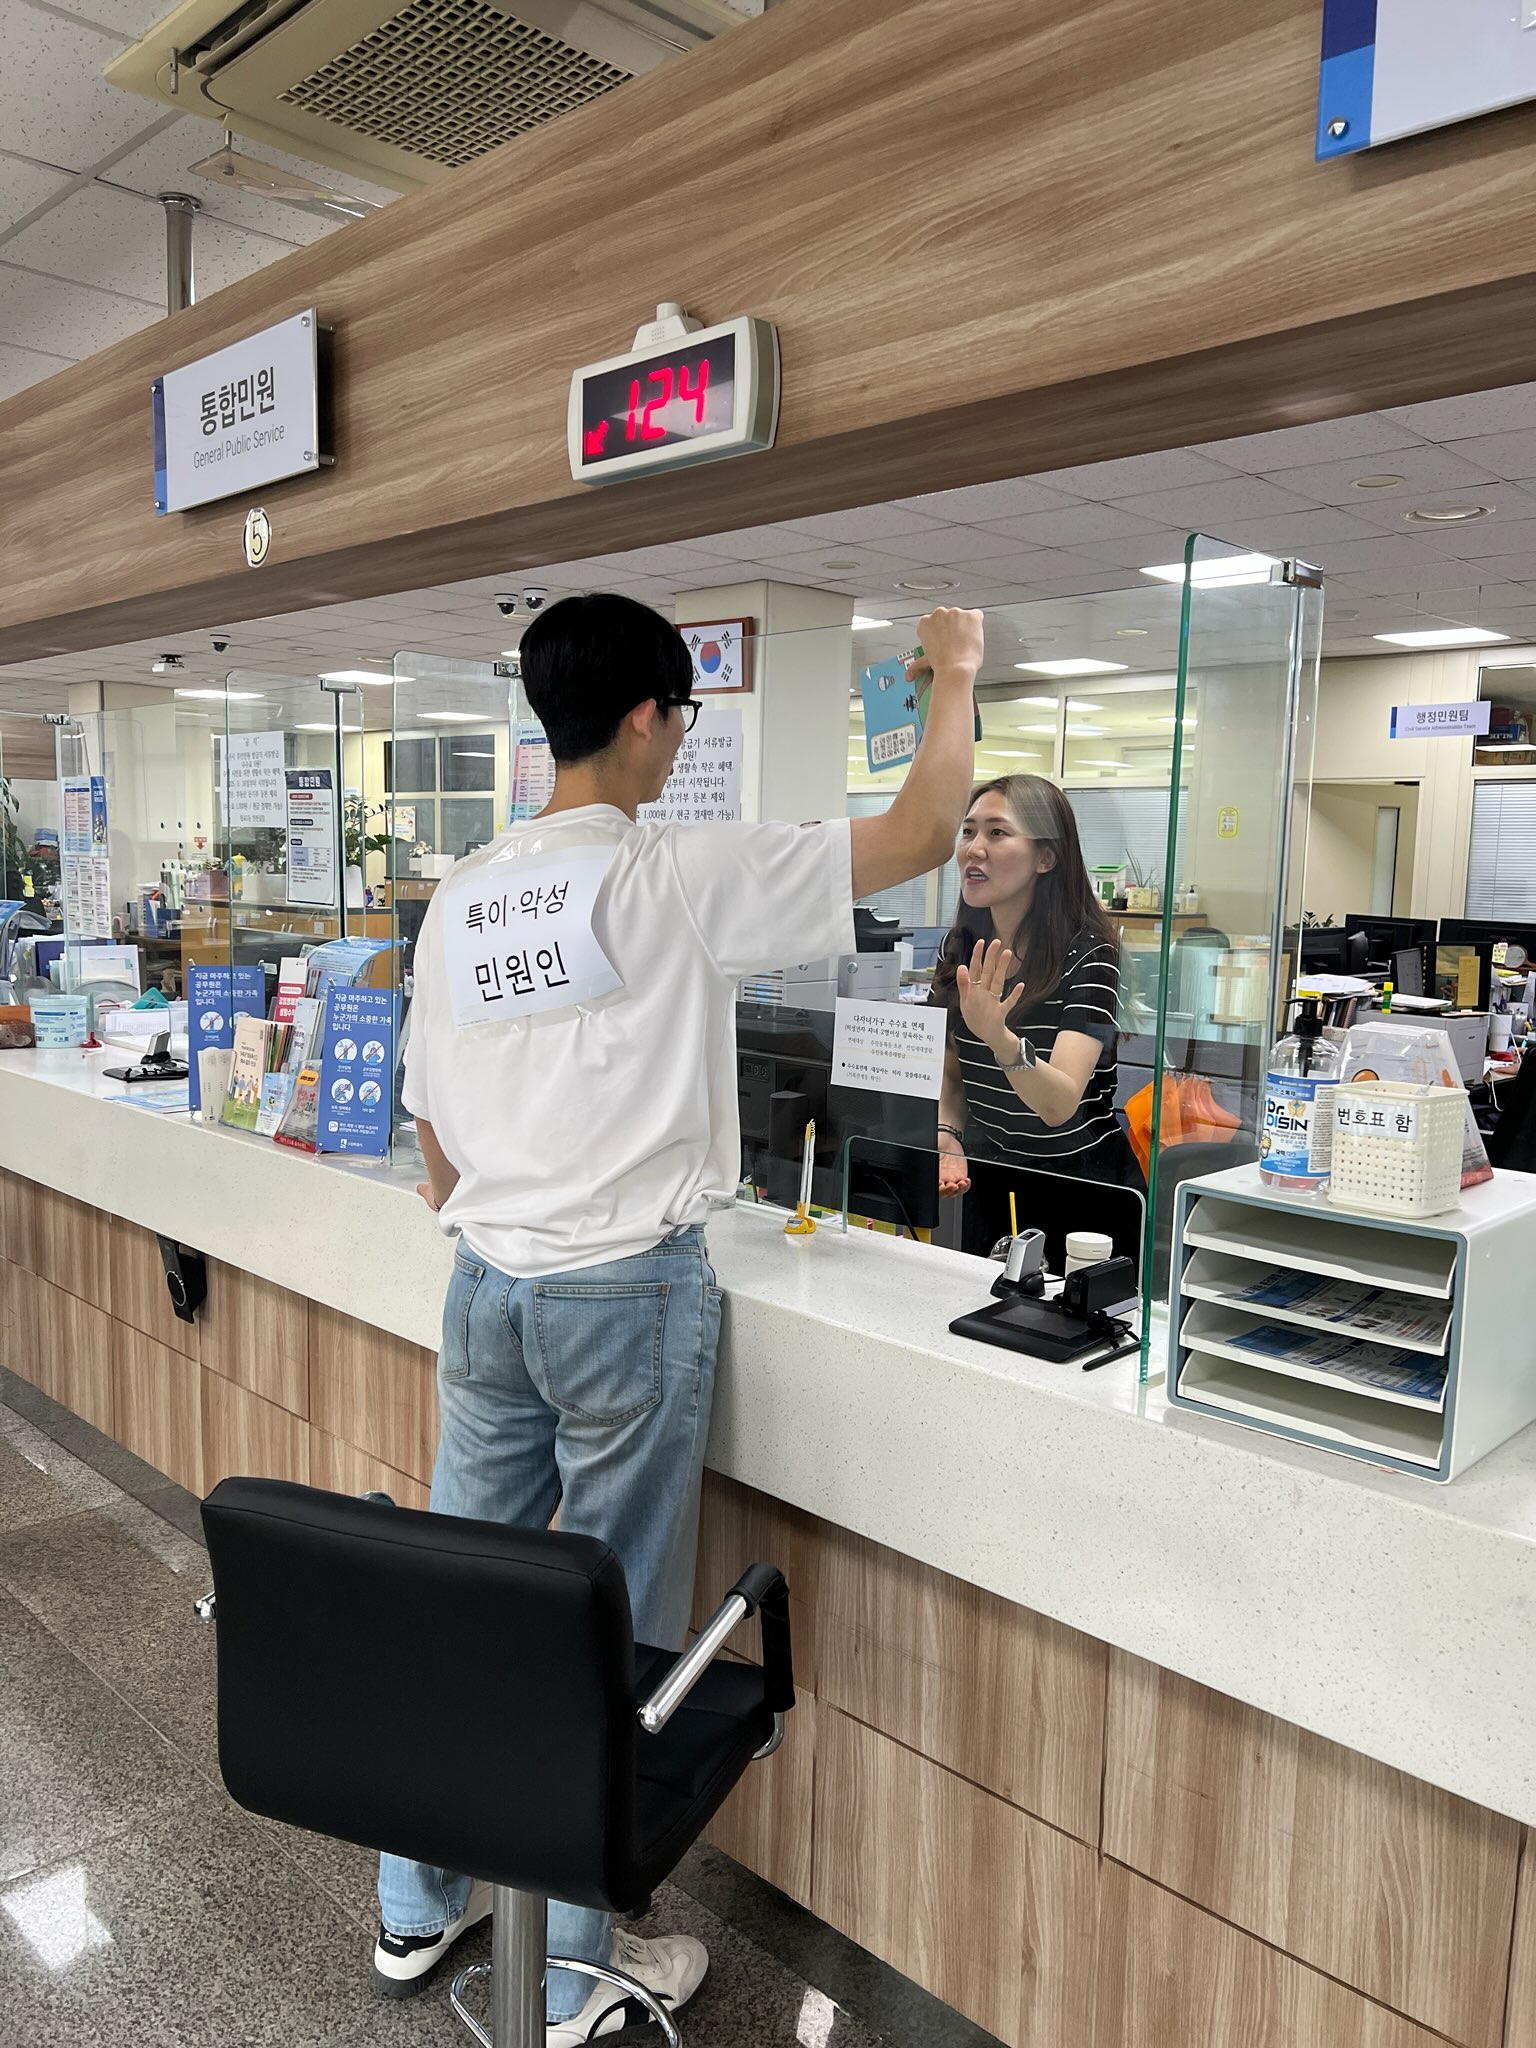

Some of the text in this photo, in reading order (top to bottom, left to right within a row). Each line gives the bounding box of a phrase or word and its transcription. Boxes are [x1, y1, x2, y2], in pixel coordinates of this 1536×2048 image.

[200, 366, 275, 436] 통합민원
[626, 359, 709, 441] 124
[194, 424, 285, 469] General Public Service
[252, 518, 263, 556] 5
[1416, 709, 1469, 724] 행정민원팀
[704, 736, 732, 748] 서류발급
[678, 762, 698, 774] 생활속
[700, 762, 714, 772] 작은
[298, 776, 320, 788] 통합민원
[688, 776, 727, 788] 시작됩니다.
[668, 792, 690, 804] 등기부
[692, 792, 708, 804] 등본
[710, 792, 725, 803] 제외
[644, 810, 666, 820] 1,000원
[676, 809, 690, 820] 현금
[717, 809, 734, 820] 가능)
[466, 880, 569, 934] 특이·악성
[475, 941, 570, 1002] 민원인
[194, 980, 222, 988] 공무원은
[194, 998, 216, 1006] 입니다.
[334, 994, 388, 1004] 지금 마주하고 있는
[334, 1003, 358, 1012] 공무원은
[332, 1013, 392, 1025] 누군가의 소중한 가족
[854, 1015, 924, 1032] 다자녀가구 수수료 면제
[332, 1022, 352, 1032] 입니다.
[1266, 1113, 1308, 1131] DISIN
[1337, 1108, 1413, 1132] 번호표 함
